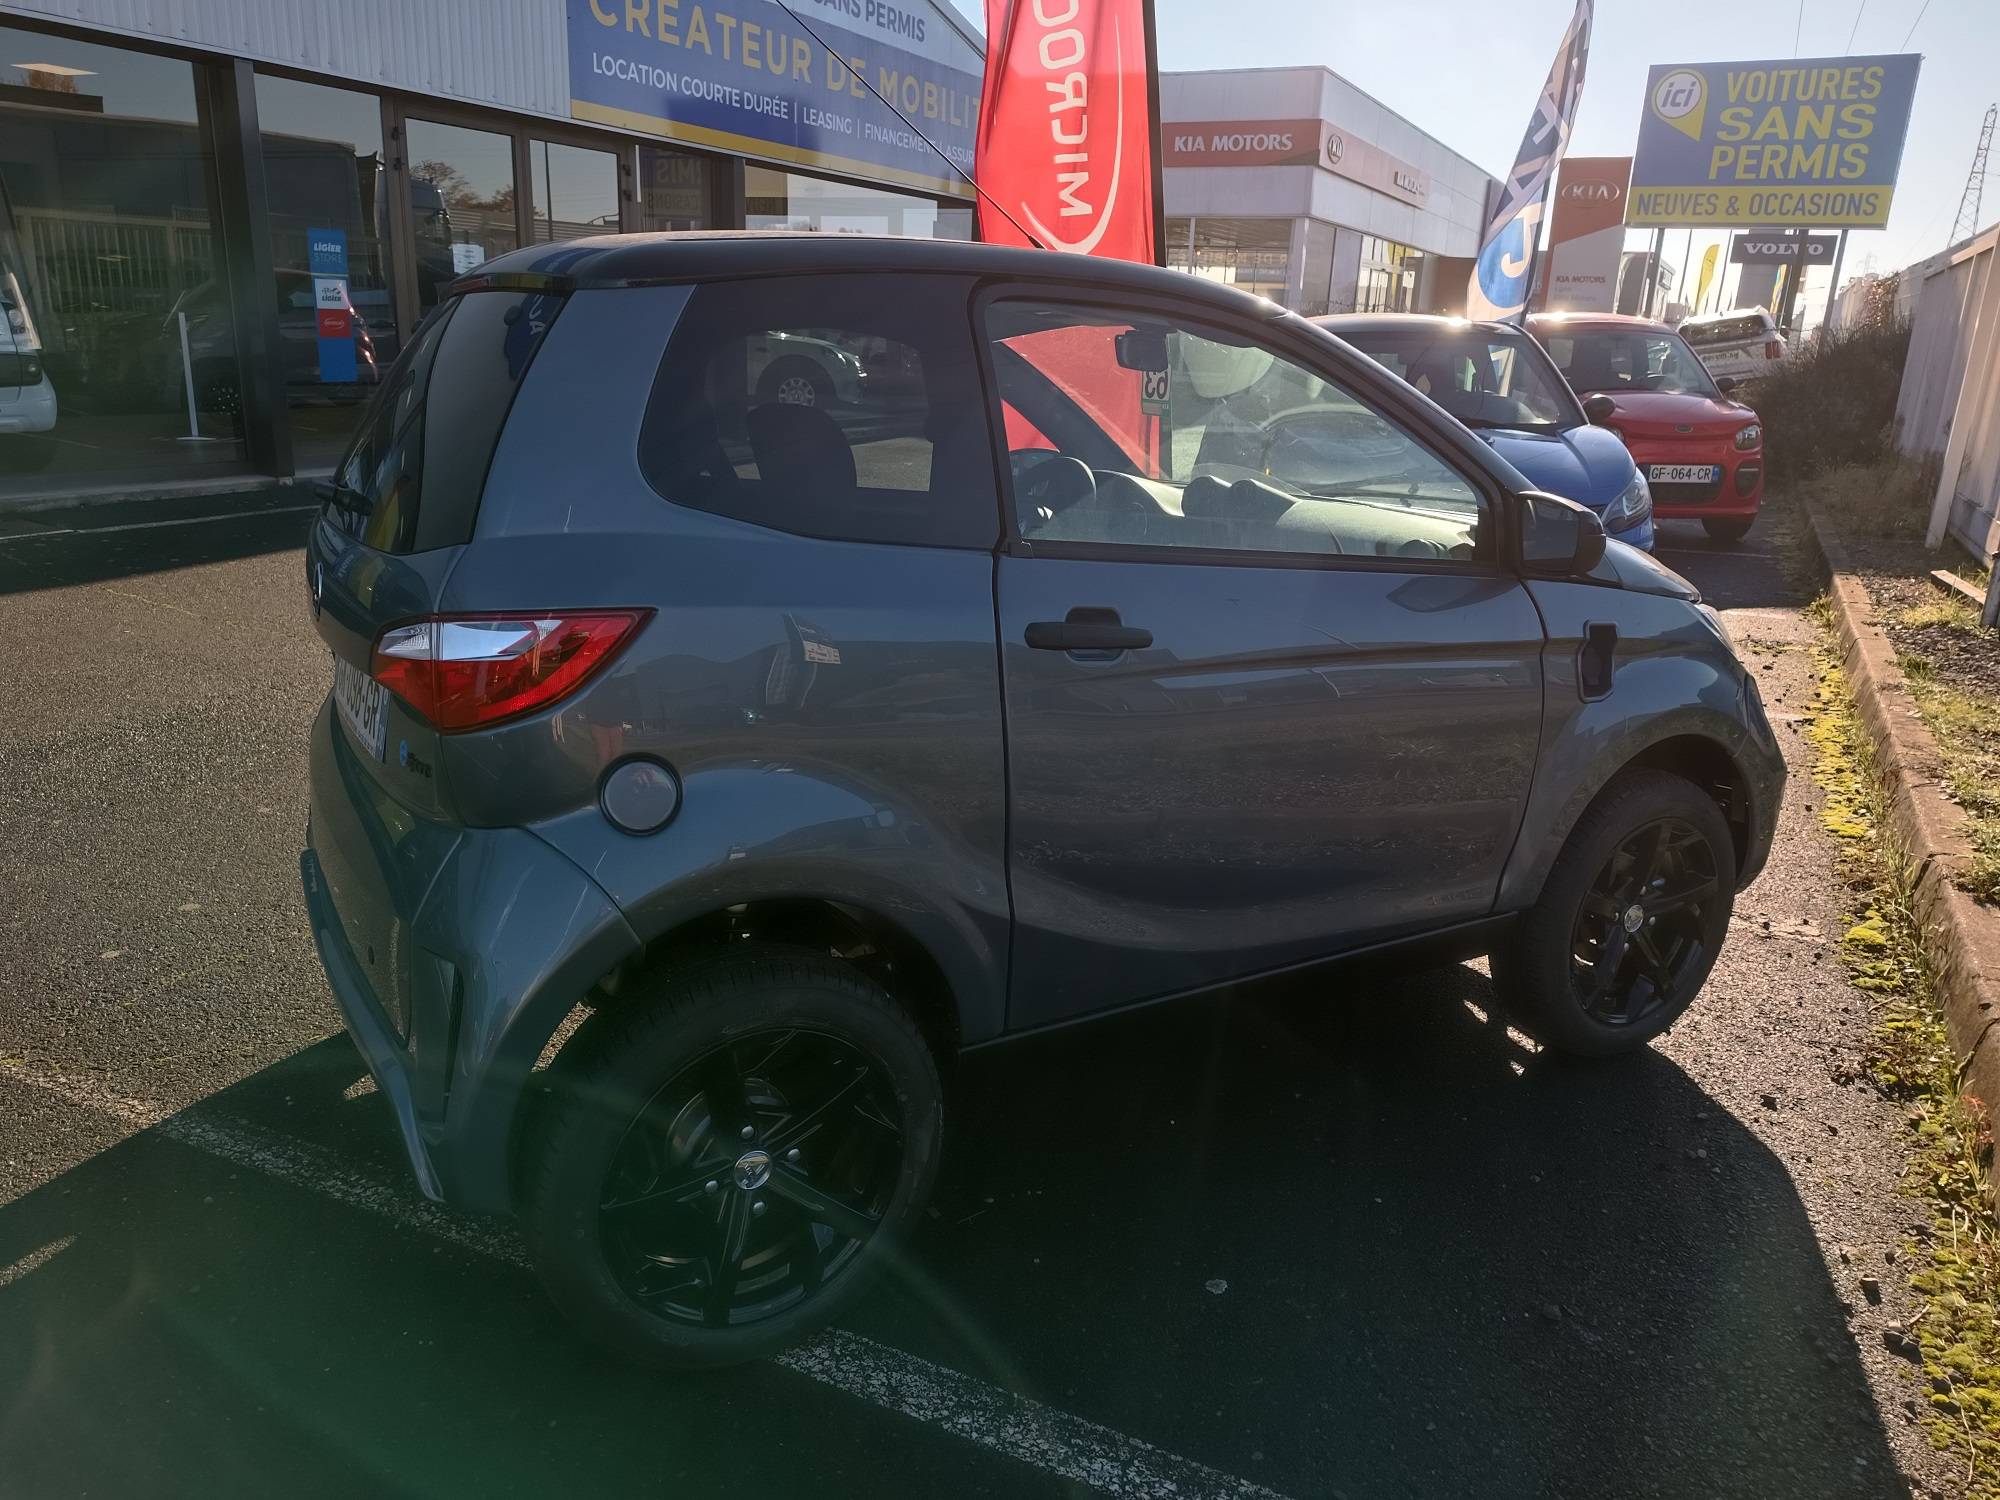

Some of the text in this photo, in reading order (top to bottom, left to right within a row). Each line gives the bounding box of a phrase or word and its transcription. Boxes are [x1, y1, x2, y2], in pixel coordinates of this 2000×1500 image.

[865, 0, 925, 42] PERMIS
[826, 50, 866, 98] DE
[1727, 66, 1885, 103] VOITURES
[592, 52, 678, 92] LOCATION
[681, 76, 741, 107] COURTE
[743, 91, 789, 120] DURÉE
[803, 107, 852, 134] LEASING
[1661, 81, 1697, 108] ici
[1716, 103, 1877, 142] SANS
[1174, 133, 1293, 153] KIA MOTORS
[1708, 143, 1869, 180] PERMIS
[1571, 184, 1609, 200] KIA
[1636, 192, 1879, 217] NEUVES & OCCASIONS
[1651, 467, 1711, 480] GF-064-CR
